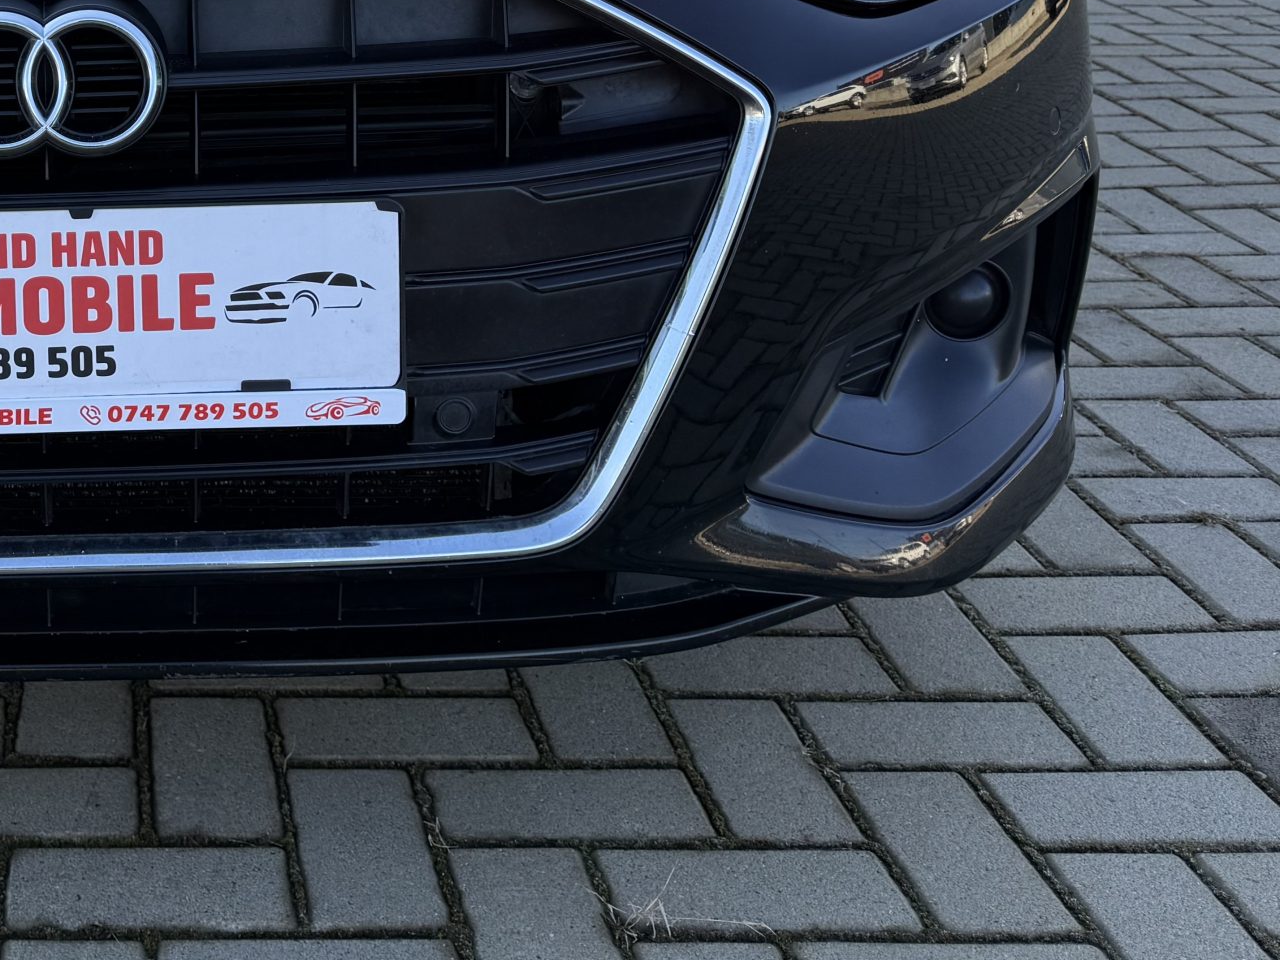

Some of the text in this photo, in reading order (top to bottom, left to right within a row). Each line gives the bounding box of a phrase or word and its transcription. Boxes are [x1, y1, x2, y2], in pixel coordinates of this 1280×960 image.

[51, 230, 164, 267] HAND
[46, 345, 118, 379] 505
[106, 404, 170, 423] 0747
[179, 402, 226, 421] 789
[232, 401, 279, 420] 505
